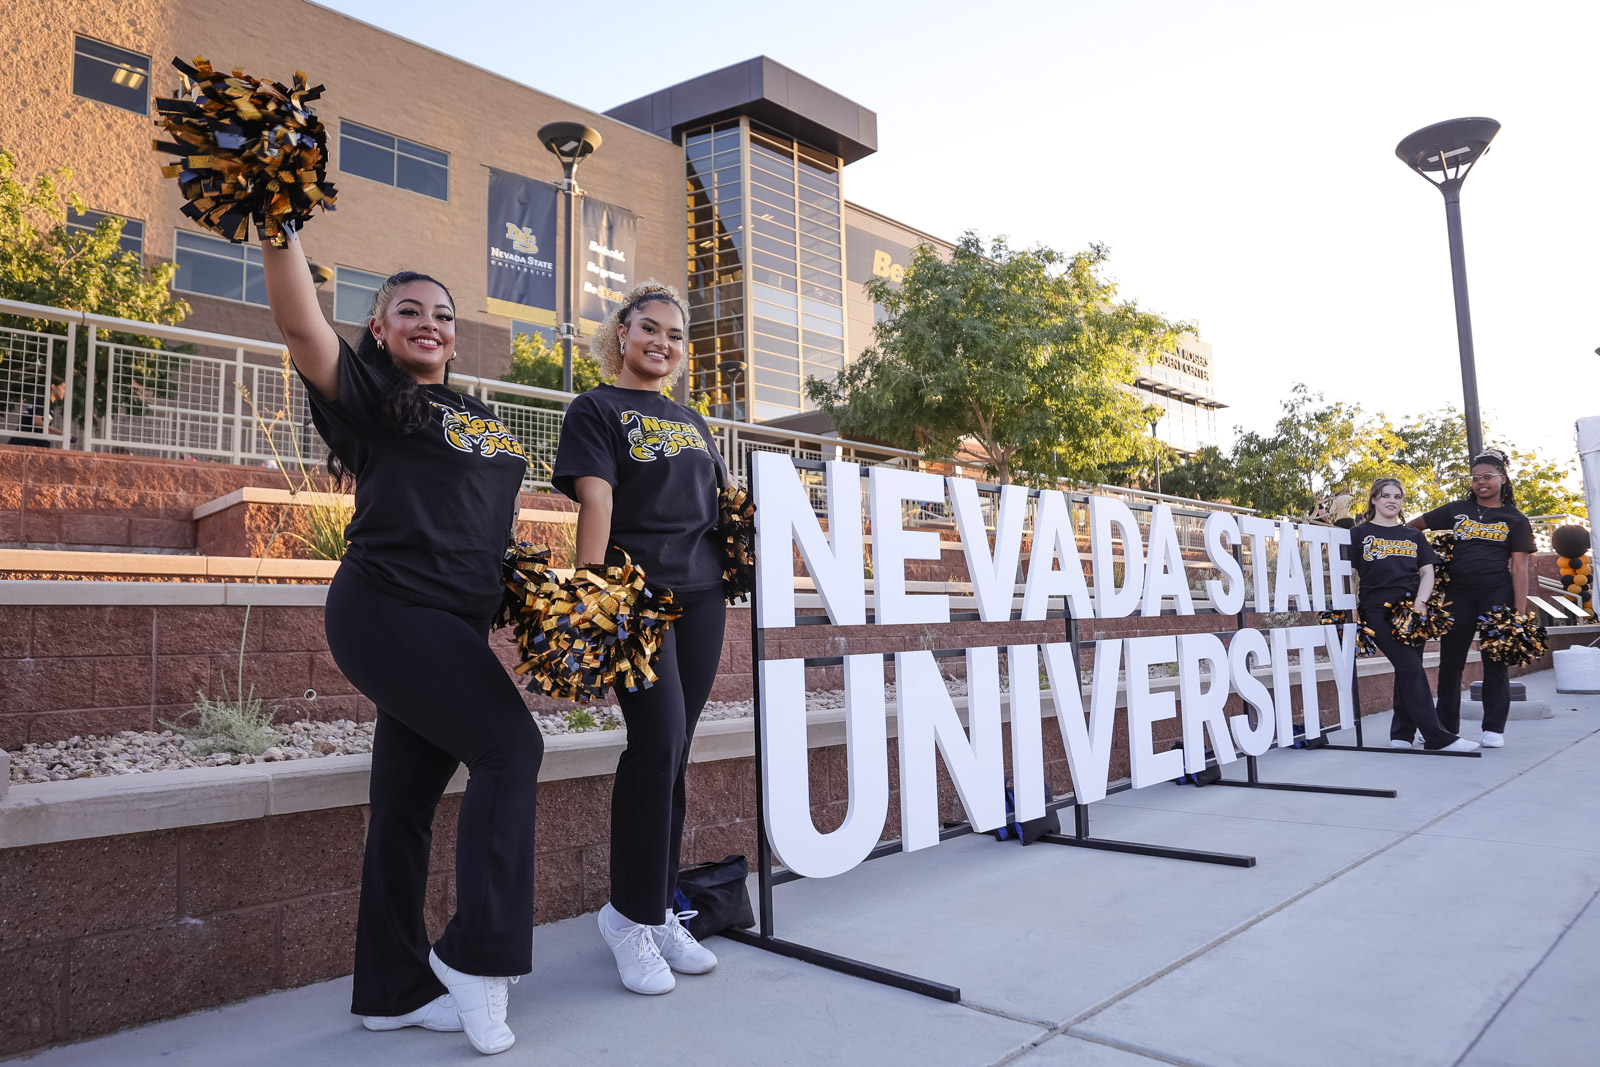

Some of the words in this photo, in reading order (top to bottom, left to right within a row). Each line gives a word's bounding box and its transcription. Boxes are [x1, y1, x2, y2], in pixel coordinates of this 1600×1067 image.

[1461, 520, 1509, 532] Nevada
[752, 451, 1195, 628] NEVADA
[1205, 511, 1356, 616] STATE
[1471, 528, 1507, 540] State
[1373, 538, 1417, 549] Nevada
[1385, 546, 1417, 556] State
[759, 623, 1356, 879] UNIVERSITY
